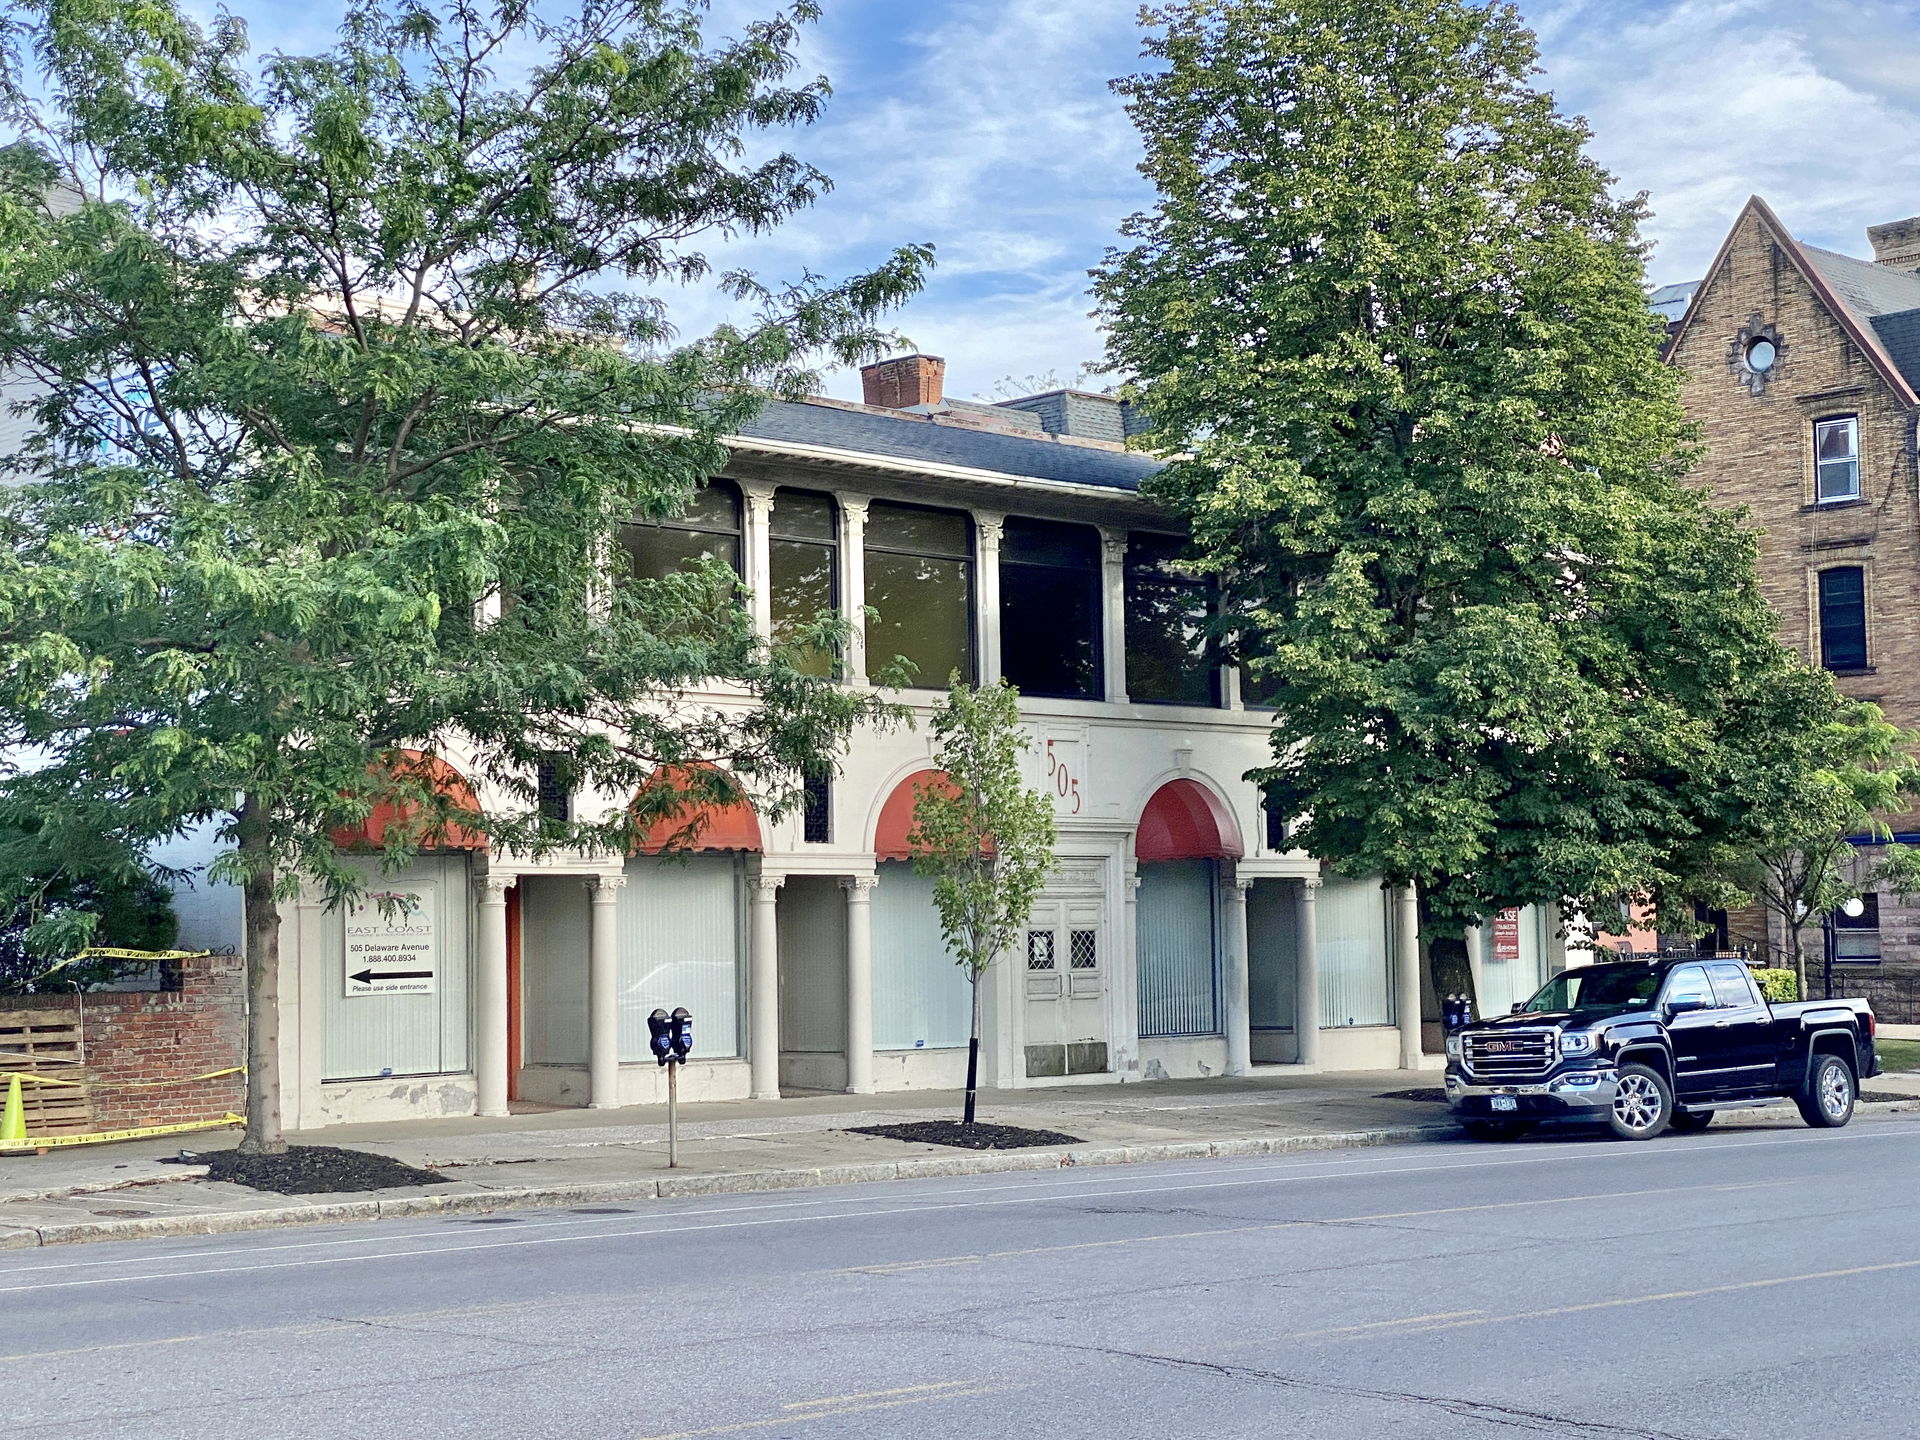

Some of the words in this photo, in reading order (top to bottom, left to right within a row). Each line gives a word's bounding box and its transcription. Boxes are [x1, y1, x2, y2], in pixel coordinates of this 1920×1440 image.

[1047, 739, 1081, 814] 505
[347, 926, 379, 934] EAST
[386, 925, 432, 933] COAST
[350, 944, 363, 952] 505
[364, 943, 399, 952] Delaware
[401, 943, 430, 951] Avenue
[363, 954, 416, 962] 1.888.400.8934
[1486, 1041, 1524, 1052] GMC
